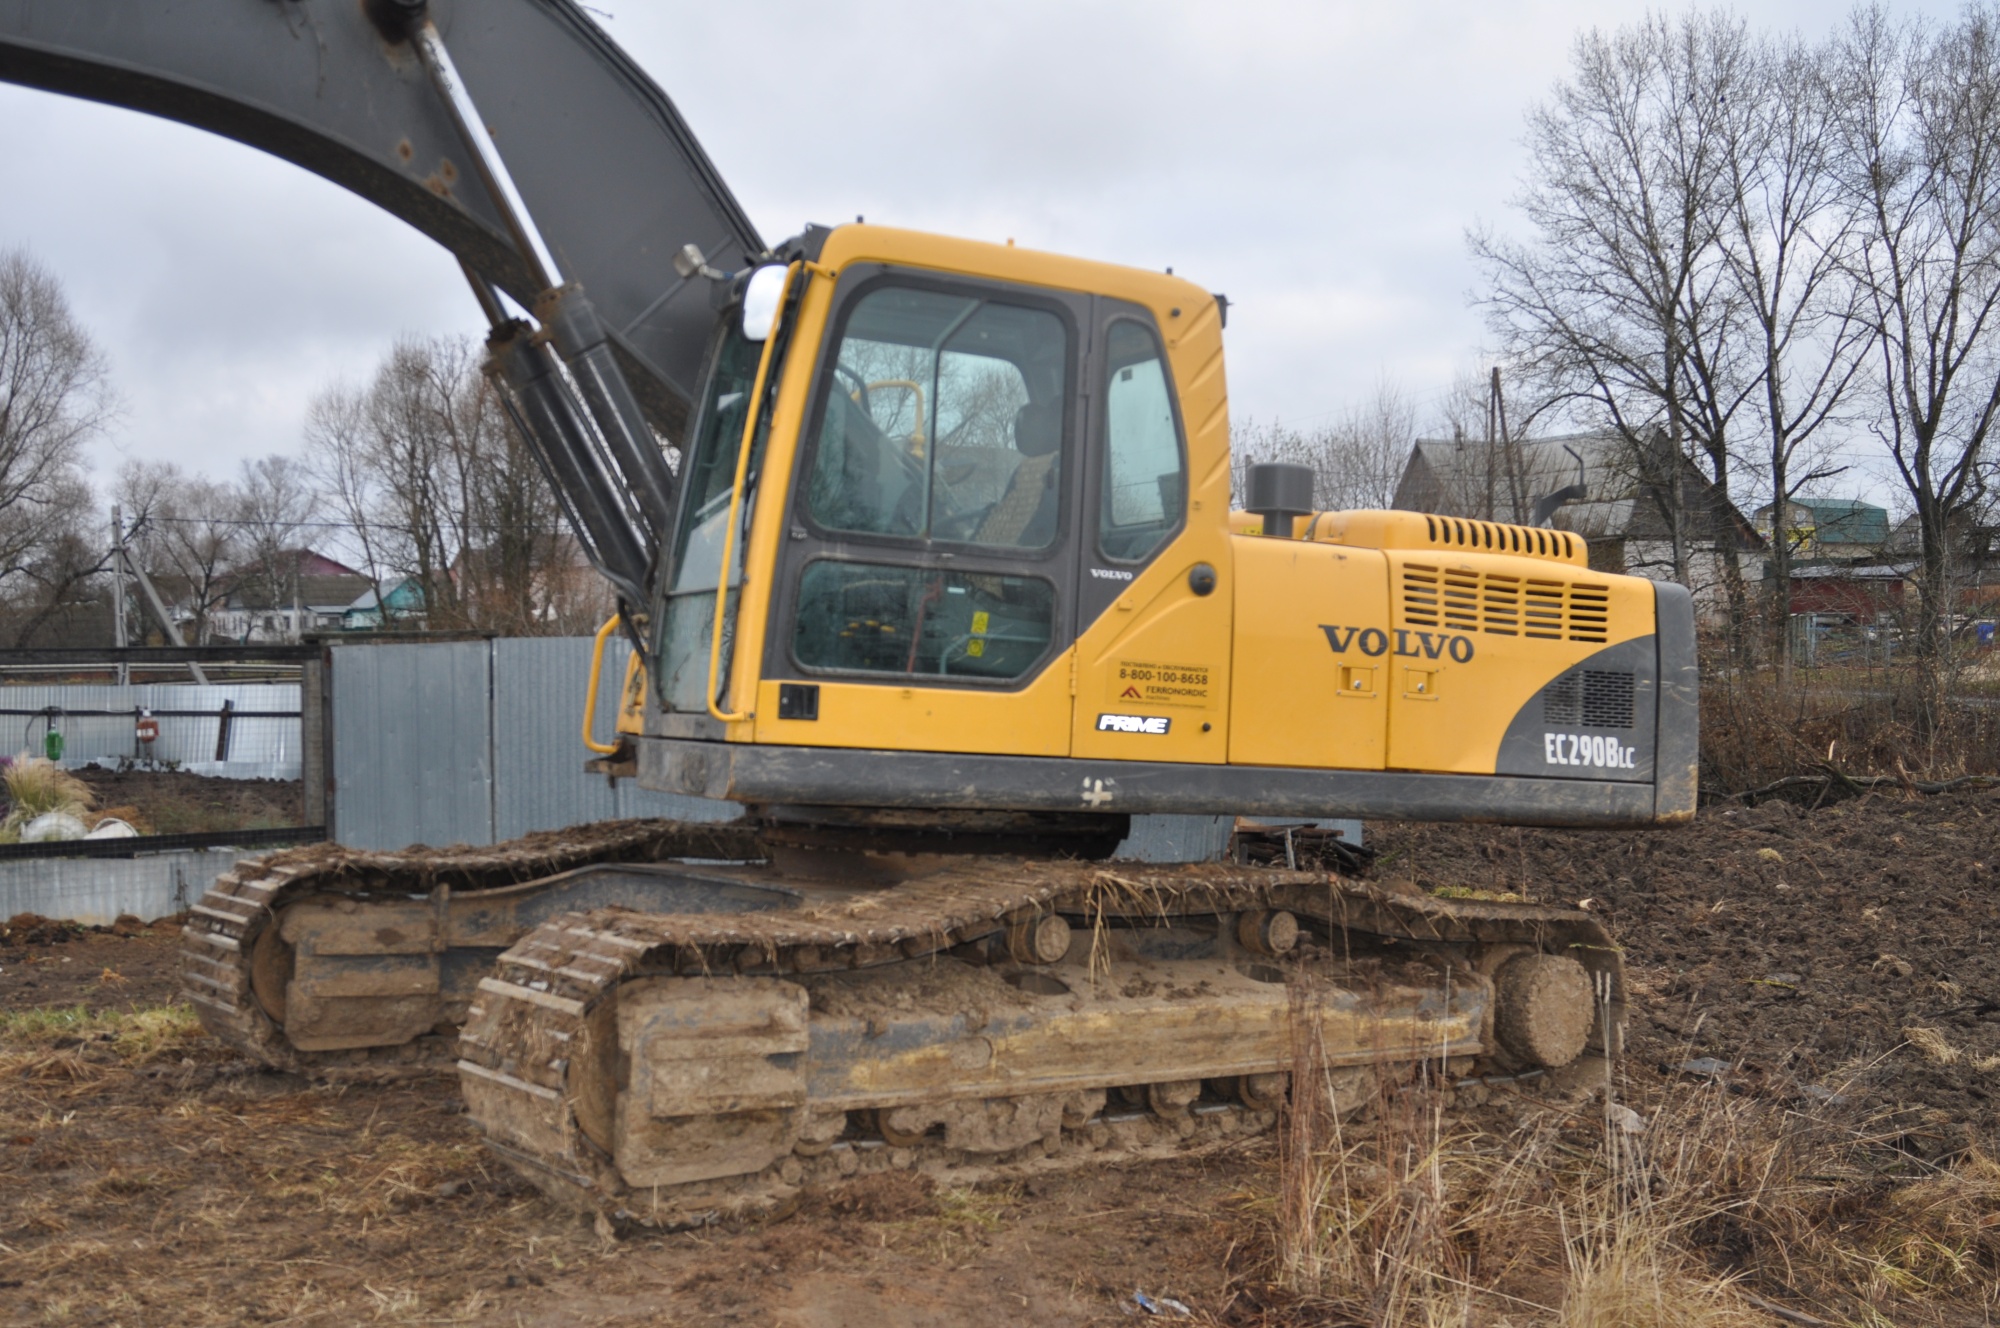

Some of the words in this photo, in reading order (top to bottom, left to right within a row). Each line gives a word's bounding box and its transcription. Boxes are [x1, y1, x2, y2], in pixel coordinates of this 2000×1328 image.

[1090, 568, 1133, 581] VOLVO
[1317, 624, 1474, 664] VOLVO
[1119, 668, 1208, 685] 8-800-100-8658
[1146, 685, 1208, 698] FERRONORDIC
[1099, 714, 1168, 734] PRIME
